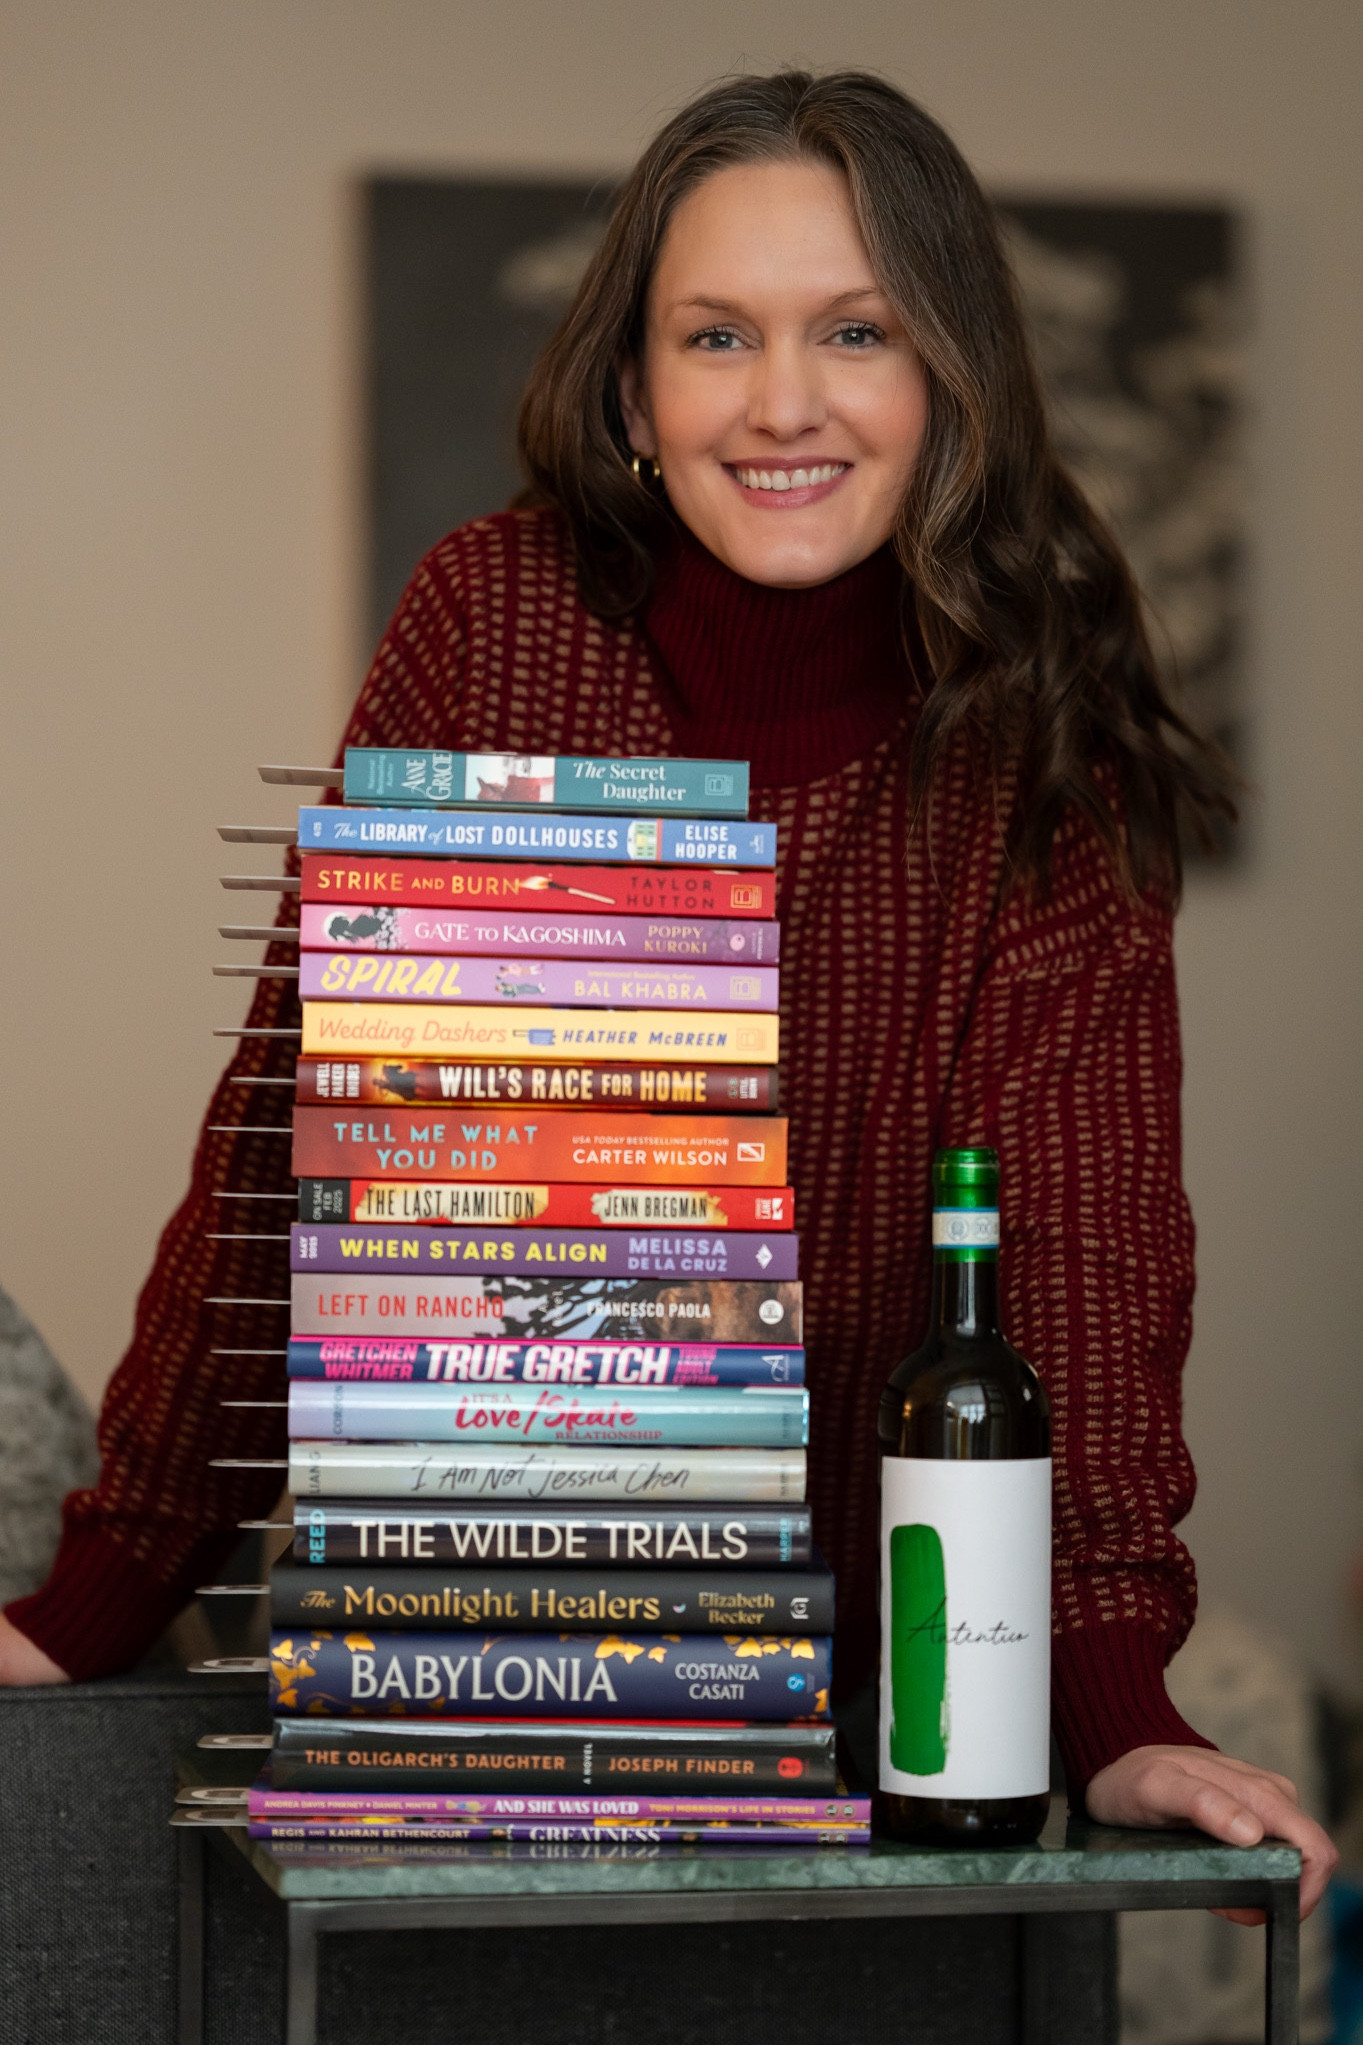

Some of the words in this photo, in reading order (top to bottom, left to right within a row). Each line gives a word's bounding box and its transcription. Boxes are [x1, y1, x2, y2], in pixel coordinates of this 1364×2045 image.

[573, 761, 606, 779] The
[610, 763, 666, 781] Secret
[603, 782, 686, 802] Daughter
[334, 822, 357, 839] The
[360, 822, 428, 842] LIBRARY
[428, 828, 444, 845] of
[446, 825, 485, 845] LOST
[491, 826, 618, 849] DOLLHOUSES
[685, 824, 728, 842] ELISE
[675, 842, 737, 860] HOOPER
[317, 869, 404, 891] STRIKE
[411, 877, 445, 890] AND
[451, 876, 520, 895] BURN
[630, 876, 712, 892] TAYLOR
[626, 895, 715, 910] HUTTON
[414, 922, 470, 942] GATE
[474, 927, 498, 940] TO
[503, 923, 626, 946] KAGOSHIMA
[648, 925, 705, 939] POPPY
[644, 939, 707, 954] KUROKI
[320, 954, 462, 996] SPIRAL
[574, 979, 611, 997] BAL
[621, 981, 707, 1000] KHABRA
[319, 1017, 416, 1049] Wedding
[422, 1020, 507, 1043] Dashers
[563, 1029, 638, 1044] HEATHER
[648, 1031, 728, 1047] McBREEN
[316, 1063, 330, 1097] JEWELL
[347, 1063, 360, 1097] RHODES
[439, 1066, 522, 1098] WILL'S
[532, 1067, 594, 1100] RACE
[601, 1073, 633, 1096] FOR
[639, 1070, 707, 1102] HOME
[334, 1123, 396, 1142] TELL
[410, 1125, 445, 1143] ME
[461, 1125, 538, 1144] WHAT
[572, 1136, 591, 1144] USA
[593, 1136, 624, 1145] TODAY
[626, 1136, 688, 1145] BESTSELLING
[689, 1137, 729, 1146] AUTHOR
[376, 1149, 436, 1170] YOU
[451, 1150, 497, 1170] DID
[572, 1149, 647, 1165] CARTER
[653, 1150, 727, 1166] WILSON
[313, 1182, 323, 1205] SALE
[333, 1189, 343, 1214] 2025
[367, 1189, 395, 1215] THE
[404, 1190, 442, 1217] LAST
[451, 1190, 534, 1219] HAMILTON
[604, 1197, 639, 1217] JENN
[644, 1197, 707, 1218] BREGMAN
[340, 1239, 419, 1258] WHEN
[429, 1241, 515, 1260] STARS
[525, 1243, 607, 1262] ALIGN
[628, 1237, 727, 1256] MELISSA
[628, 1257, 649, 1270] DE
[655, 1258, 675, 1270] LA
[680, 1258, 727, 1272] CRUZ
[318, 1294, 368, 1316] LEFT
[378, 1295, 406, 1317] ON
[416, 1296, 504, 1319] RANCHO
[587, 1302, 664, 1318] FRANCESCO
[668, 1303, 711, 1319] PAOLA
[319, 1342, 419, 1362] GRETCHEN
[325, 1363, 414, 1380] WHITMER
[425, 1344, 522, 1381] TRUE
[522, 1345, 672, 1383] GRETCH
[555, 1430, 662, 1441] RELATIONSHIP
[410, 1456, 432, 1492] I
[528, 1459, 618, 1498] Jessica
[625, 1462, 690, 1495] Chen
[309, 1508, 326, 1563] REED
[351, 1520, 435, 1558] THE
[449, 1520, 587, 1559] WILDE
[601, 1521, 748, 1560] TRIALS
[300, 1590, 336, 1609] The
[344, 1585, 519, 1624] Moonlight
[531, 1588, 660, 1620] Healers
[698, 1591, 775, 1610] Elizabeth
[708, 1609, 765, 1625] Becker
[906, 1596, 1029, 1645] Autentico
[351, 1654, 618, 1702] BABYLONIA
[674, 1662, 760, 1681] COSTANZA
[688, 1683, 745, 1700] CASATI
[305, 1750, 341, 1765] THE
[347, 1751, 459, 1768] OLIGARCH'S
[465, 1754, 566, 1770] DAUGHTER
[583, 1743, 592, 1776] NOVEL
[608, 1757, 678, 1773] JOSEPH
[685, 1759, 755, 1775] FINDER
[264, 1801, 299, 1809] ANDREA
[301, 1801, 325, 1809] DAVIS
[327, 1802, 364, 1810] PINKNEY
[372, 1802, 404, 1810] DANIEL
[406, 1802, 438, 1810] MINTER
[493, 1800, 525, 1813] AND
[527, 1800, 556, 1813] SHE
[558, 1801, 590, 1814] WAS
[592, 1801, 640, 1815] LOVED
[650, 1804, 674, 1812] TONI
[676, 1804, 737, 1813] MORRISON'S
[739, 1805, 759, 1814] LIFE
[762, 1806, 773, 1814] IN
[776, 1805, 816, 1814] STORIES
[271, 1828, 305, 1837] REGIS
[328, 1828, 379, 1838] KAHRAN
[382, 1829, 471, 1838] BETHENCOURT
[529, 1826, 661, 1841] GREATNESS
